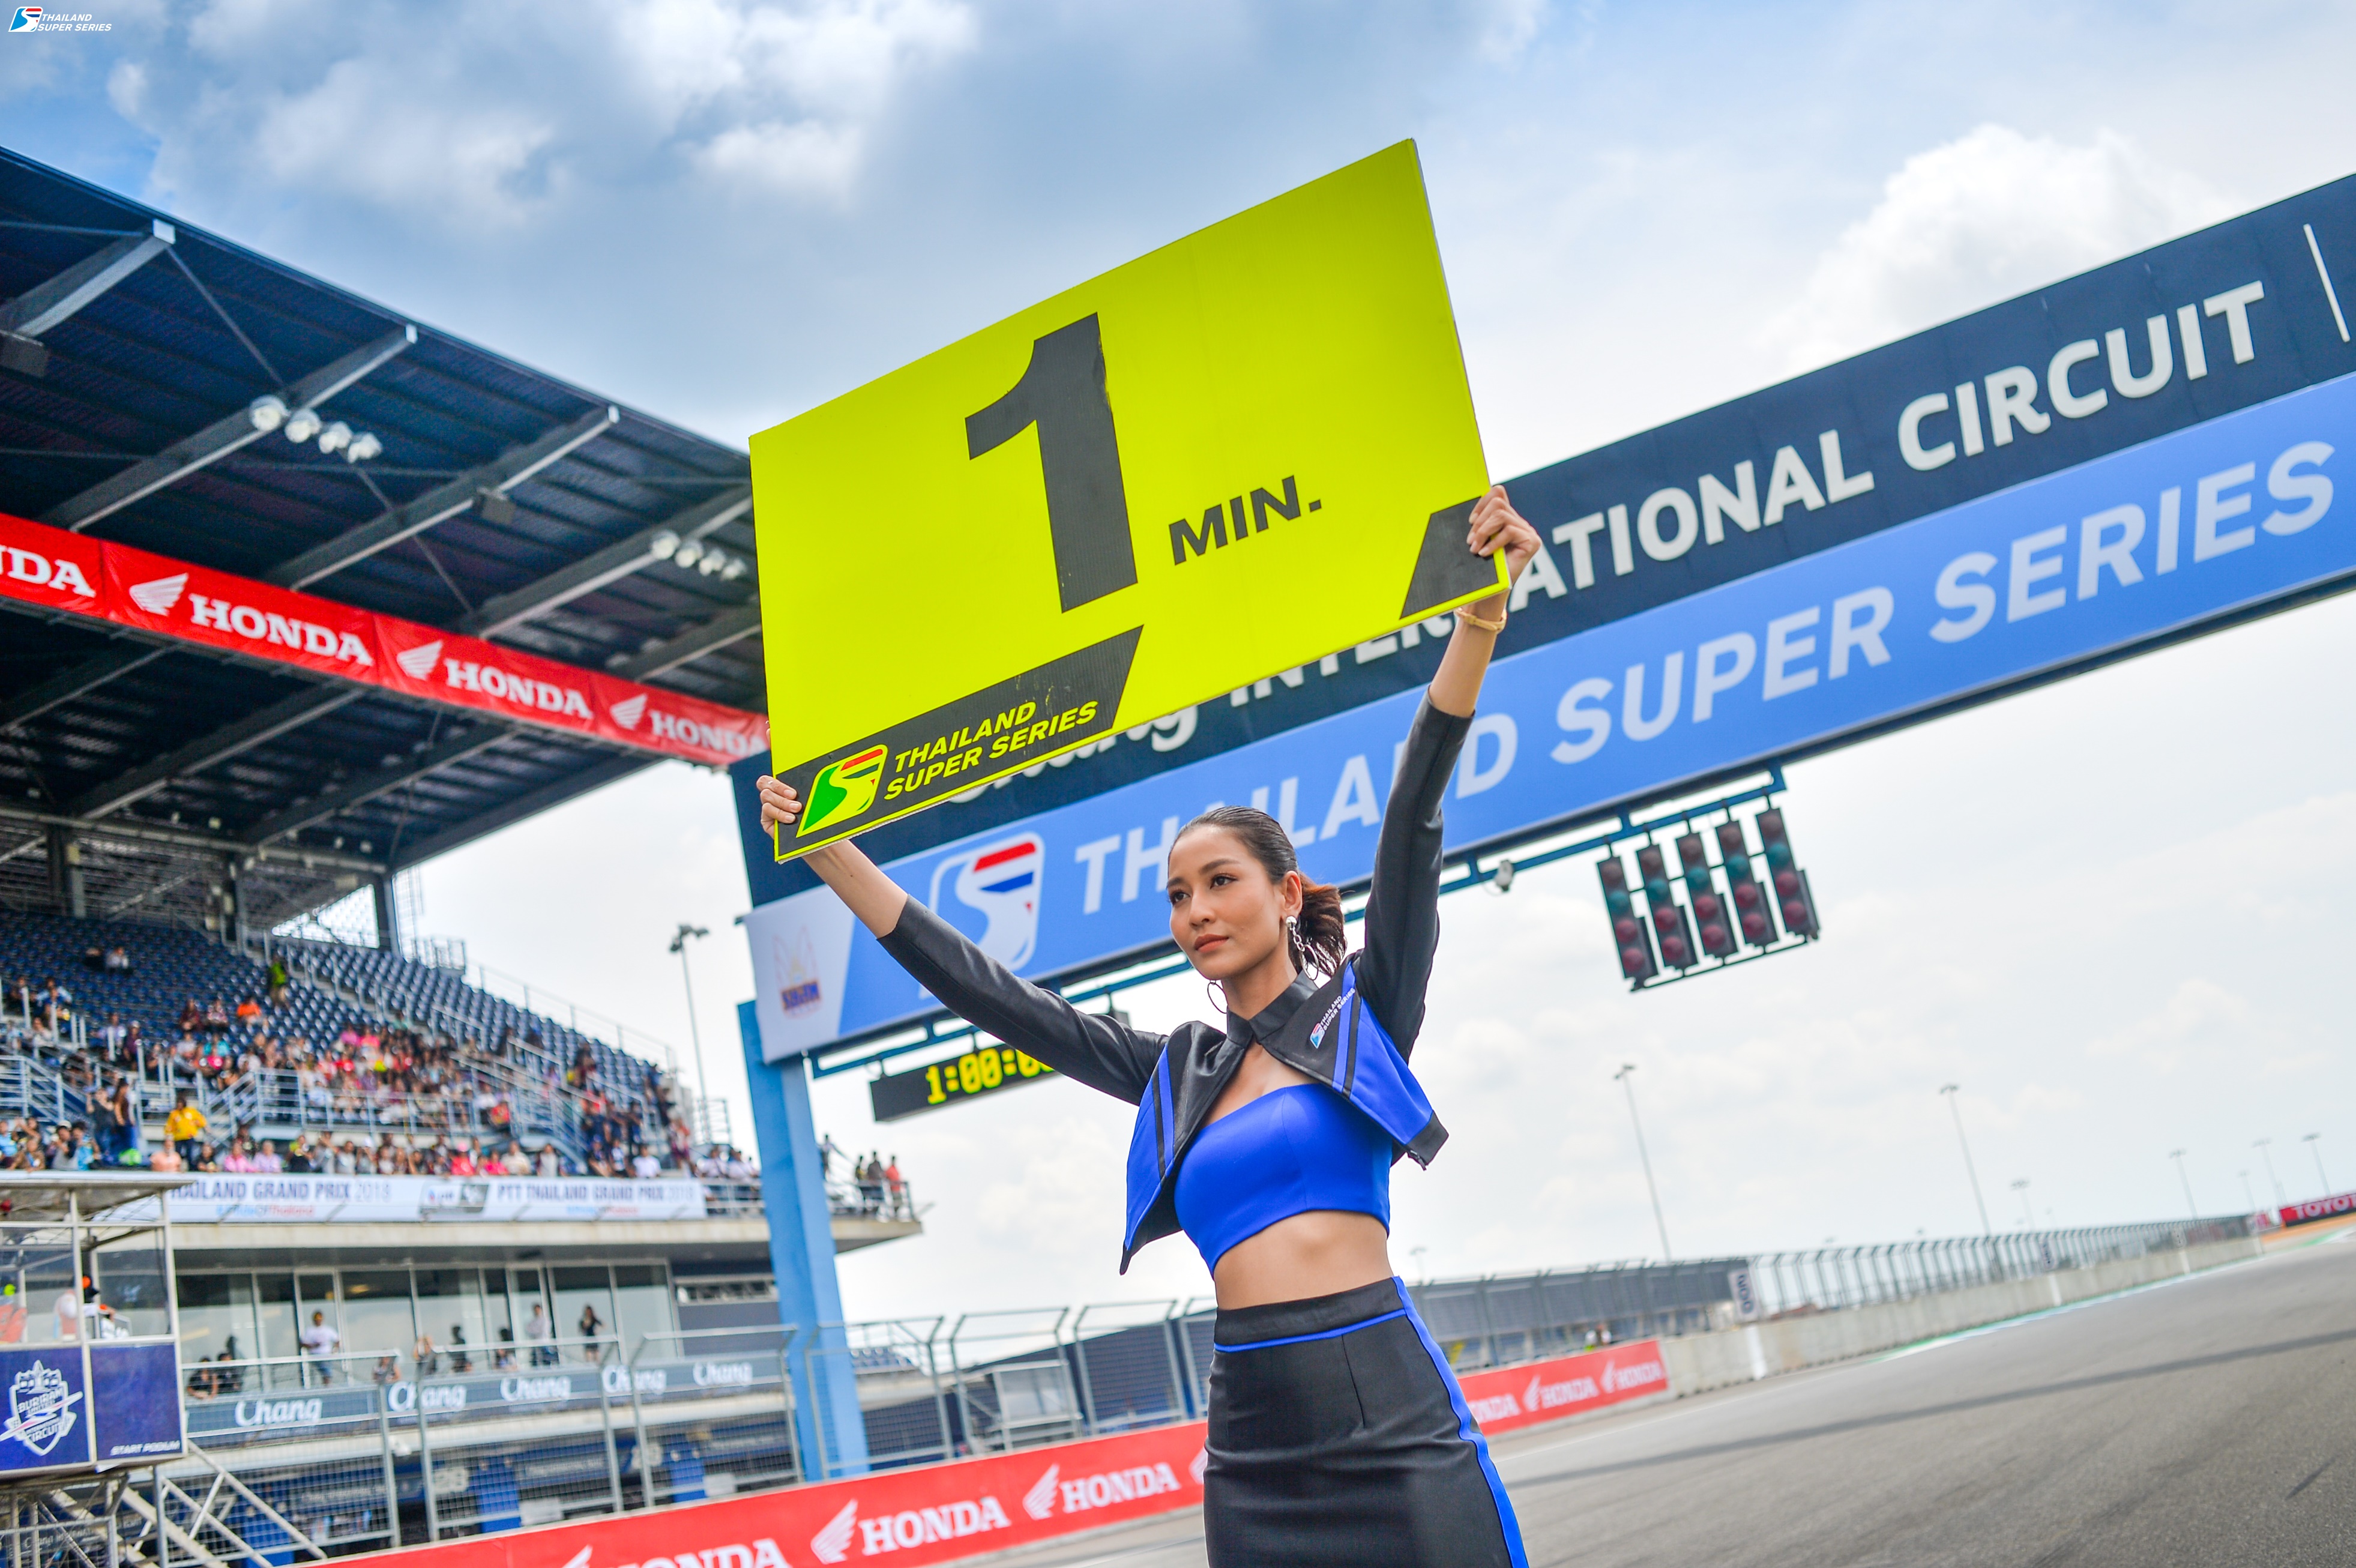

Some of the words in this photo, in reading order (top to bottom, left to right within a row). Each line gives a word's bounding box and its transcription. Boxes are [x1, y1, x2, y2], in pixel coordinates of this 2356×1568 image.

[1897, 280, 2265, 471] CIRCUIT
[965, 312, 1138, 614] 1
[1169, 475, 1322, 565] MIN.
[1550, 586, 1894, 765] SUPER
[1929, 441, 2336, 642] SERIES
[188, 593, 373, 666] HONDA
[444, 658, 594, 719] HONDA
[649, 710, 767, 757] HONDA
[884, 746, 981, 800] SUPER
[988, 700, 1098, 760] SERIES
[894, 701, 1037, 773] THAILAND
[1321, 996, 1342, 1026] THAILAND
[1323, 1009, 1339, 1031] SUPER
[1337, 988, 1355, 1010] SERIES
[253, 1181, 307, 1199] GRAND
[316, 1182, 349, 1199] PRIX
[526, 1184, 588, 1201] THAILAND
[500, 1375, 571, 1402] Chang
[693, 1362, 753, 1387] Chang
[235, 1398, 322, 1426] Chang
[1061, 1462, 1181, 1514] HONDA
[858, 1496, 1011, 1556] HONDA
